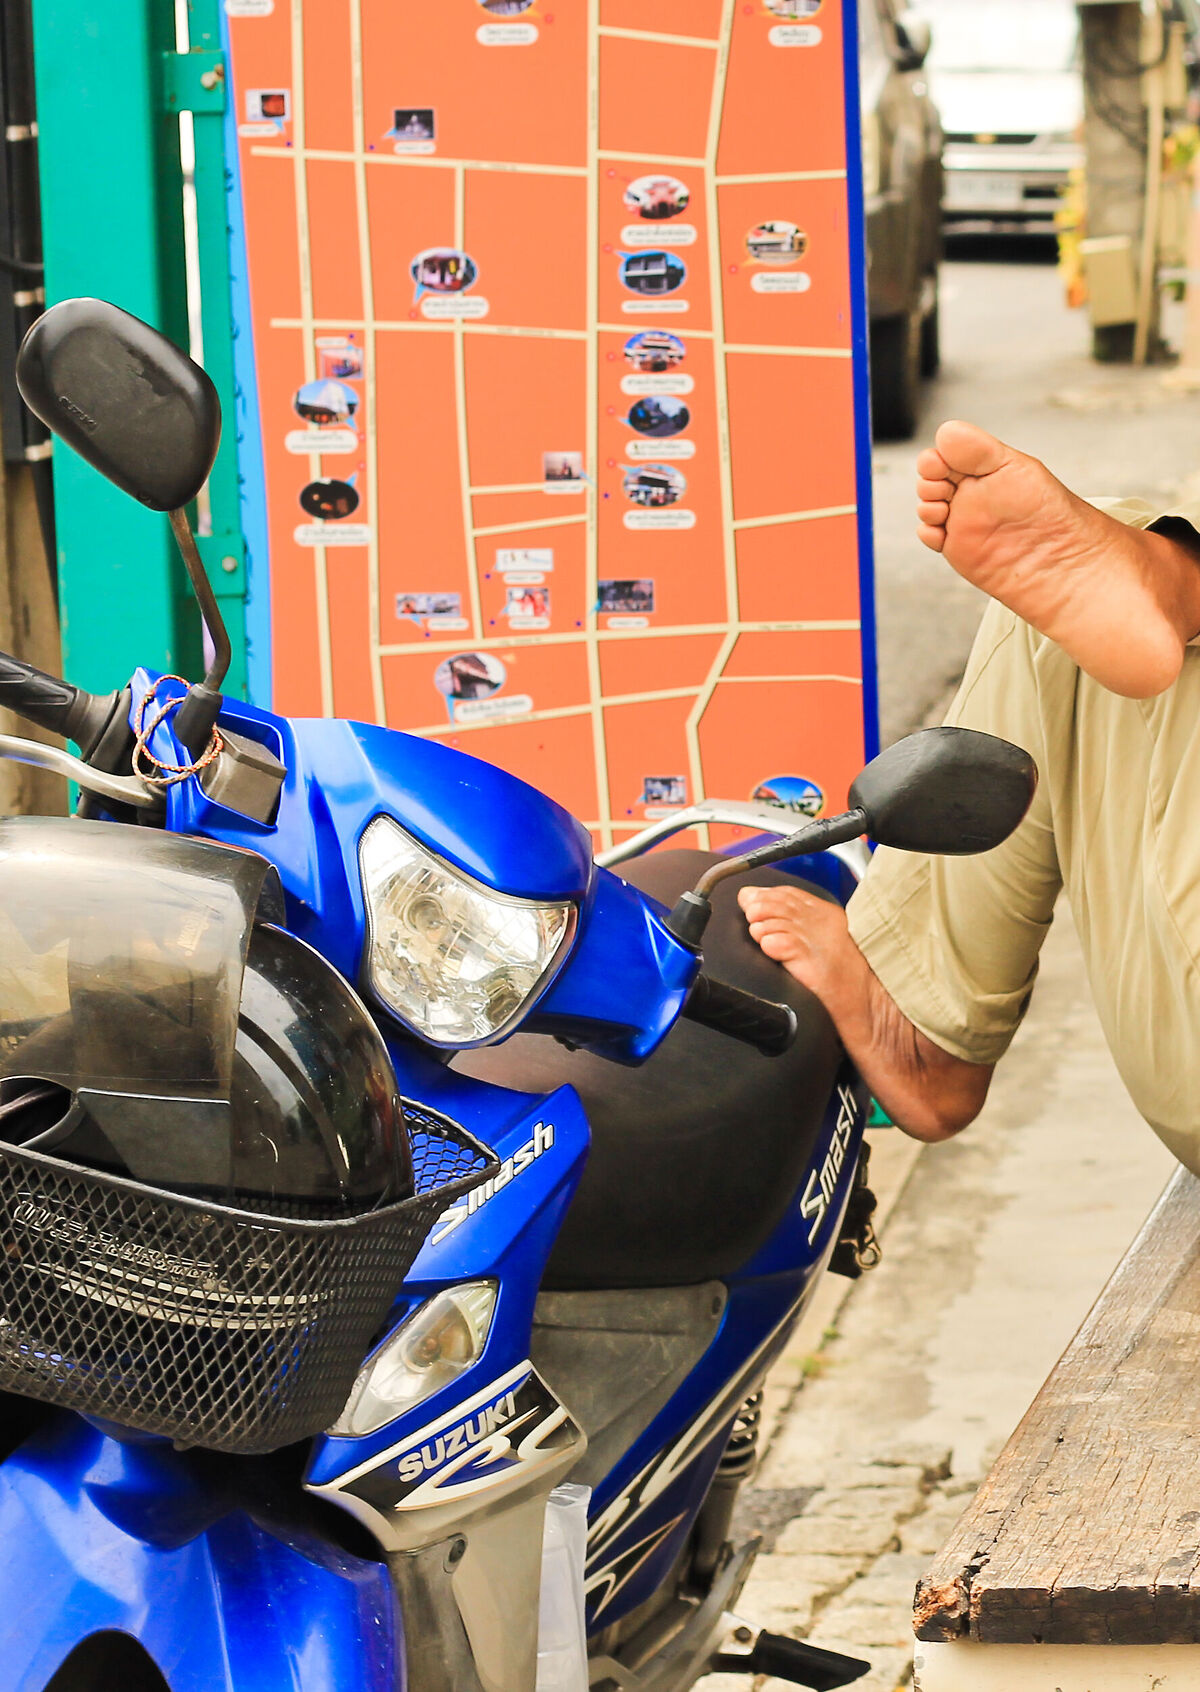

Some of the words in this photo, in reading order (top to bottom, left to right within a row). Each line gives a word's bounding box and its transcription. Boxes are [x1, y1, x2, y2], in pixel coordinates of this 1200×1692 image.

[431, 1121, 555, 1246] Smash
[800, 1083, 858, 1246] Smash
[398, 1390, 518, 1484] SUZUKI
